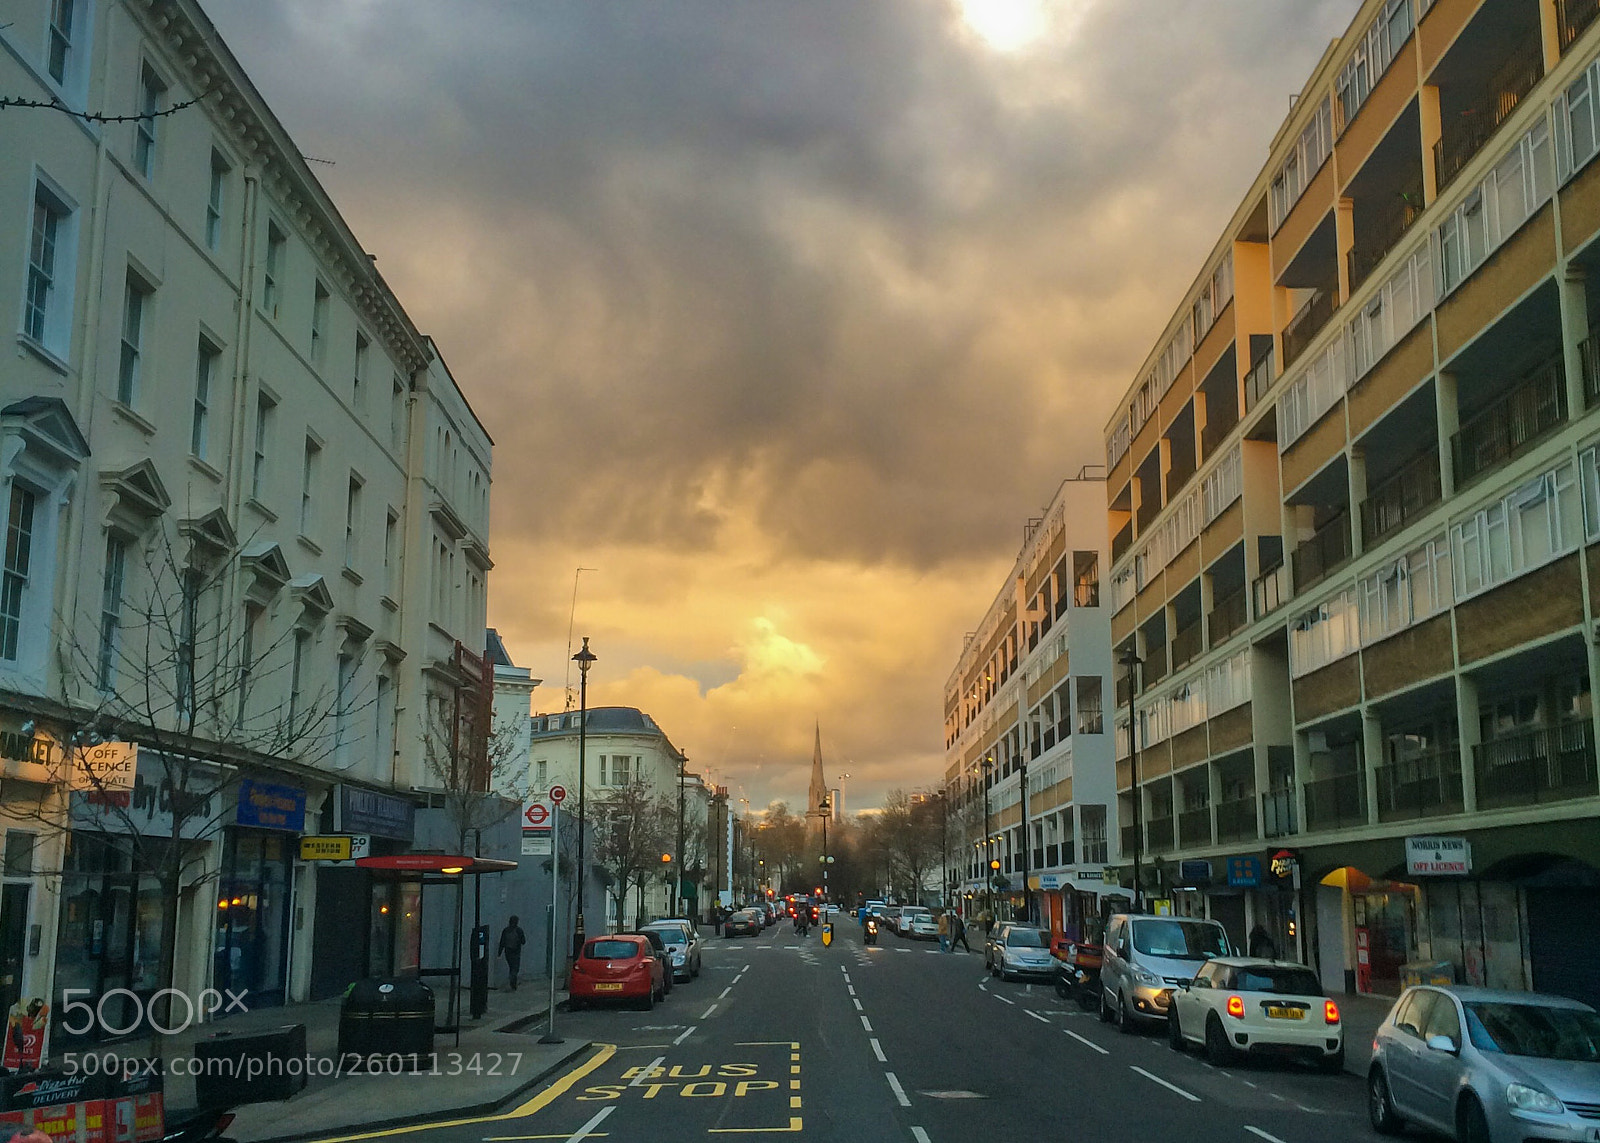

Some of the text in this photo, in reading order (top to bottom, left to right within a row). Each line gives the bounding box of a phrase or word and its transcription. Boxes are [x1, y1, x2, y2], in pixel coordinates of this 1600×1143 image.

[94, 749, 118, 759] OFF
[77, 762, 131, 772] LCENCE
[1441, 840, 1464, 850] NEWS
[1413, 862, 1464, 871] OFF LICENCE
[620, 1063, 759, 1080] BUS
[39, 1075, 87, 1091] Pizza Hut
[33, 1089, 80, 1104] DELIVERY
[576, 1080, 779, 1101] STOP
